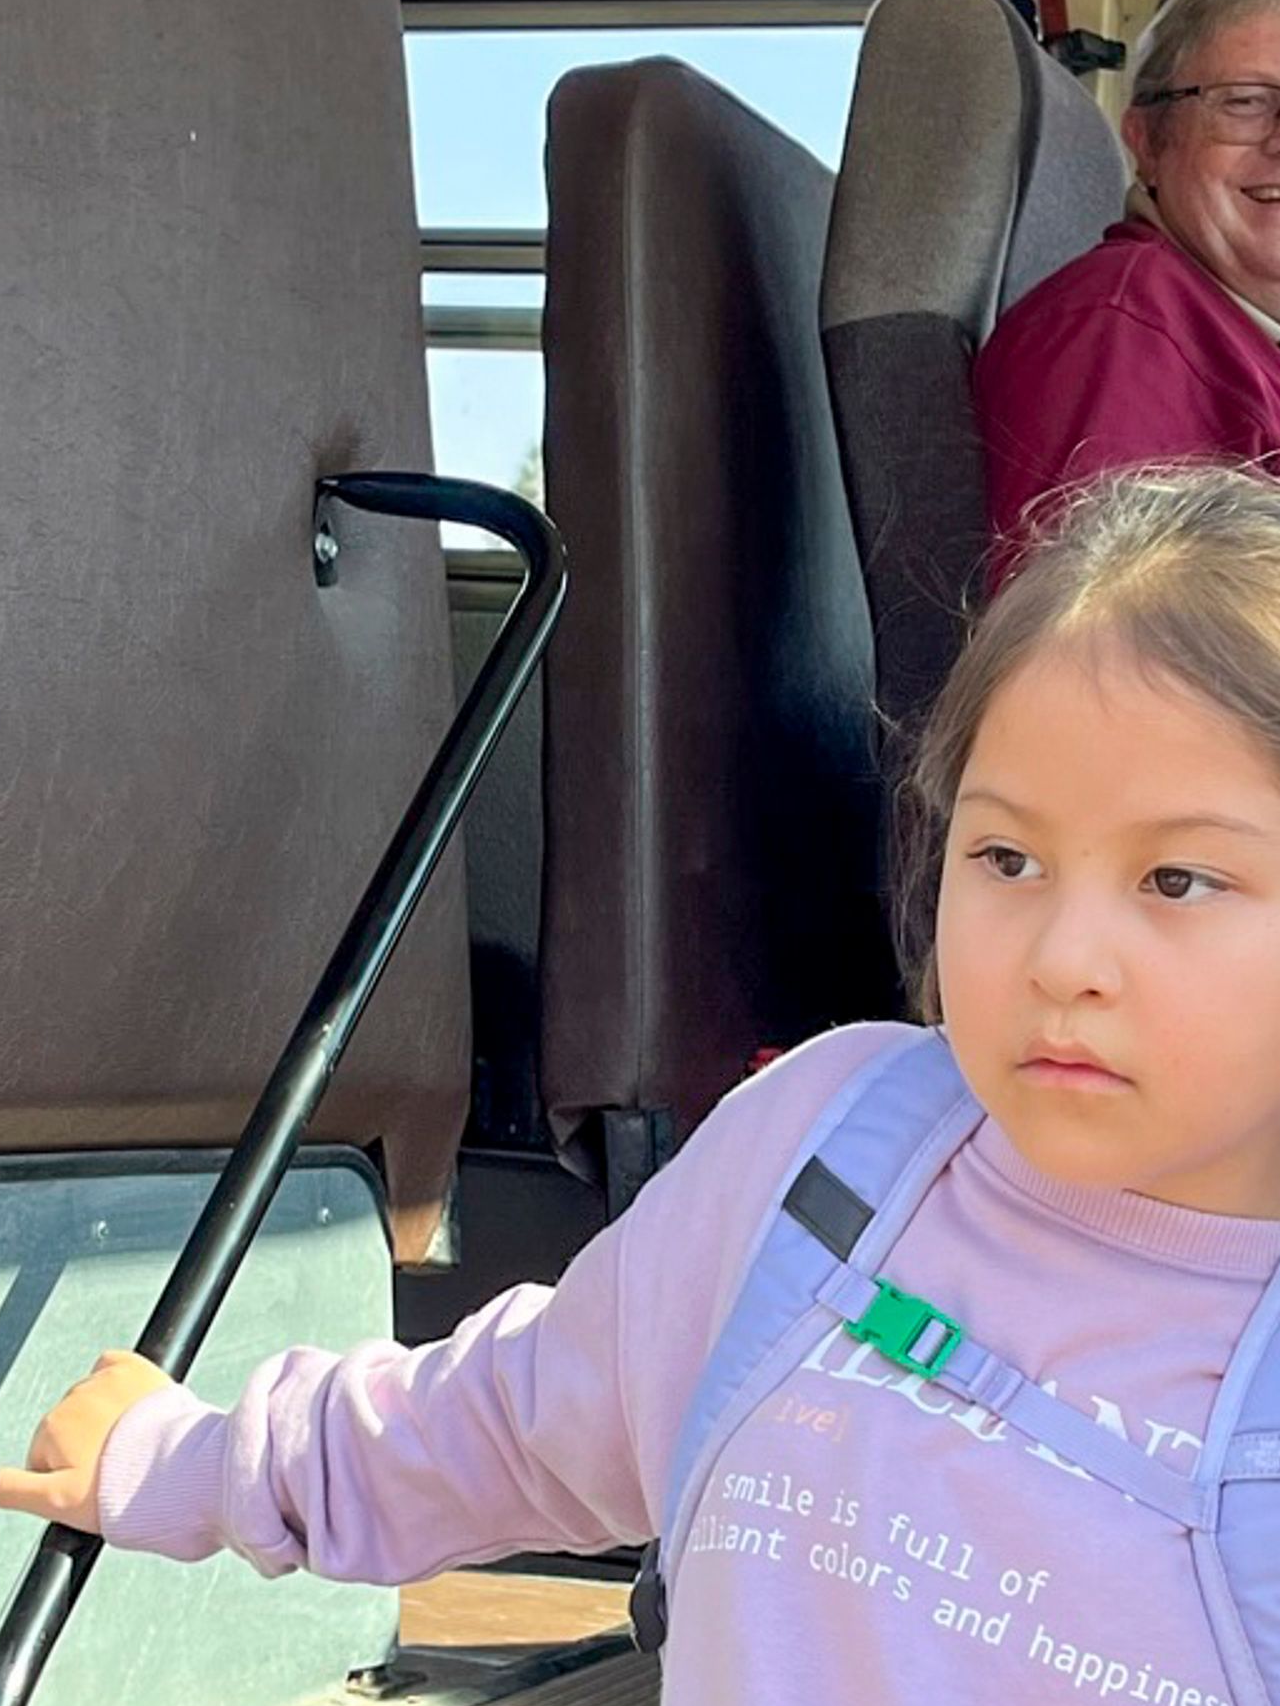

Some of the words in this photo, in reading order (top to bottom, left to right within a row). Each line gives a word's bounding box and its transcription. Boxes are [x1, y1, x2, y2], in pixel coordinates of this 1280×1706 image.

[690, 1515, 787, 1561] illiant
[809, 1541, 914, 1603] colors
[932, 1592, 1007, 1648] and
[722, 1470, 816, 1517] smile
[830, 1489, 860, 1528] is
[888, 1513, 972, 1581] full
[999, 1566, 1053, 1606] of
